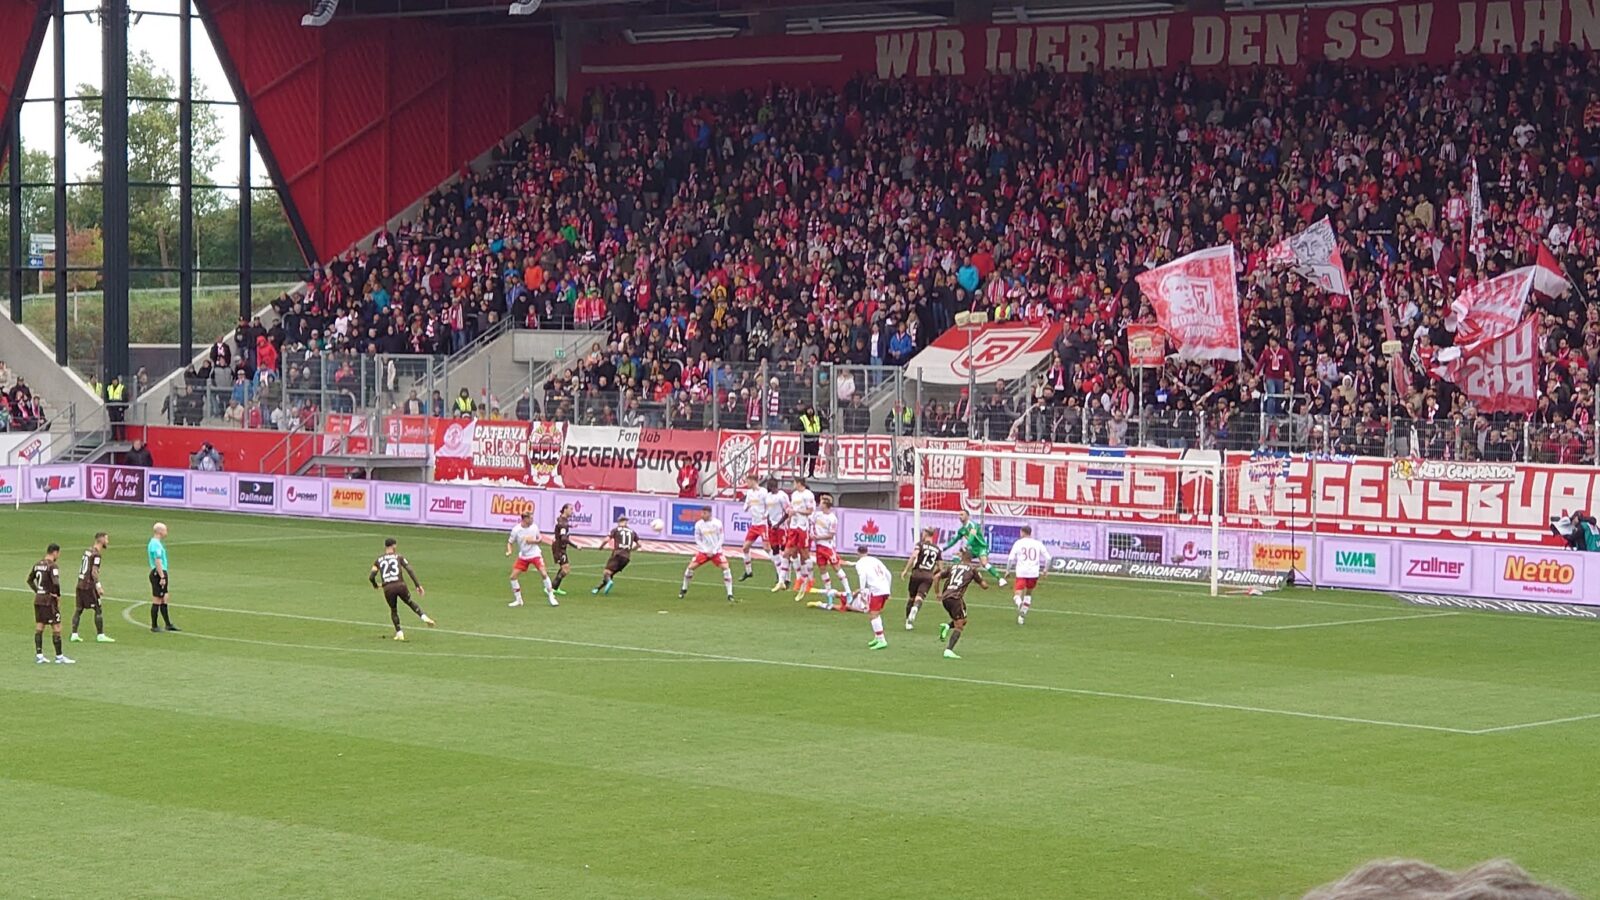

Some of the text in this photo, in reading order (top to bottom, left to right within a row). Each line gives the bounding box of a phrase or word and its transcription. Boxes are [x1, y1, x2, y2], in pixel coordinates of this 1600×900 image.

[875, 0, 1600, 80] WIR LIEBEN DEN SSV JAHN
[474, 425, 527, 440] CATERVA
[617, 429, 661, 442] Fanclub
[473, 454, 525, 468] RATISBONA
[926, 454, 965, 479] 1889
[240, 492, 273, 503] Dallmeier
[342, 491, 365, 501] LOTTO
[384, 493, 403, 505] LVM
[1238, 461, 1600, 527] REGENSBUR
[429, 497, 467, 514] zollner
[490, 494, 535, 516] Netto
[628, 509, 657, 518] ECKERT
[619, 530, 632, 549] 11
[854, 532, 887, 543] SCHMID
[1020, 547, 1037, 562] 30
[1110, 548, 1160, 560] Dallmeier
[1269, 549, 1301, 560] LOTTO
[1335, 551, 1364, 568] LVM
[380, 558, 400, 578] 23
[1065, 560, 1122, 573] Dallmeier
[1224, 570, 1283, 585] Dallmeier
[1406, 557, 1465, 579] zollner
[1504, 555, 1575, 585] Netto
[36, 571, 44, 590] 2
[950, 568, 964, 586] 14
